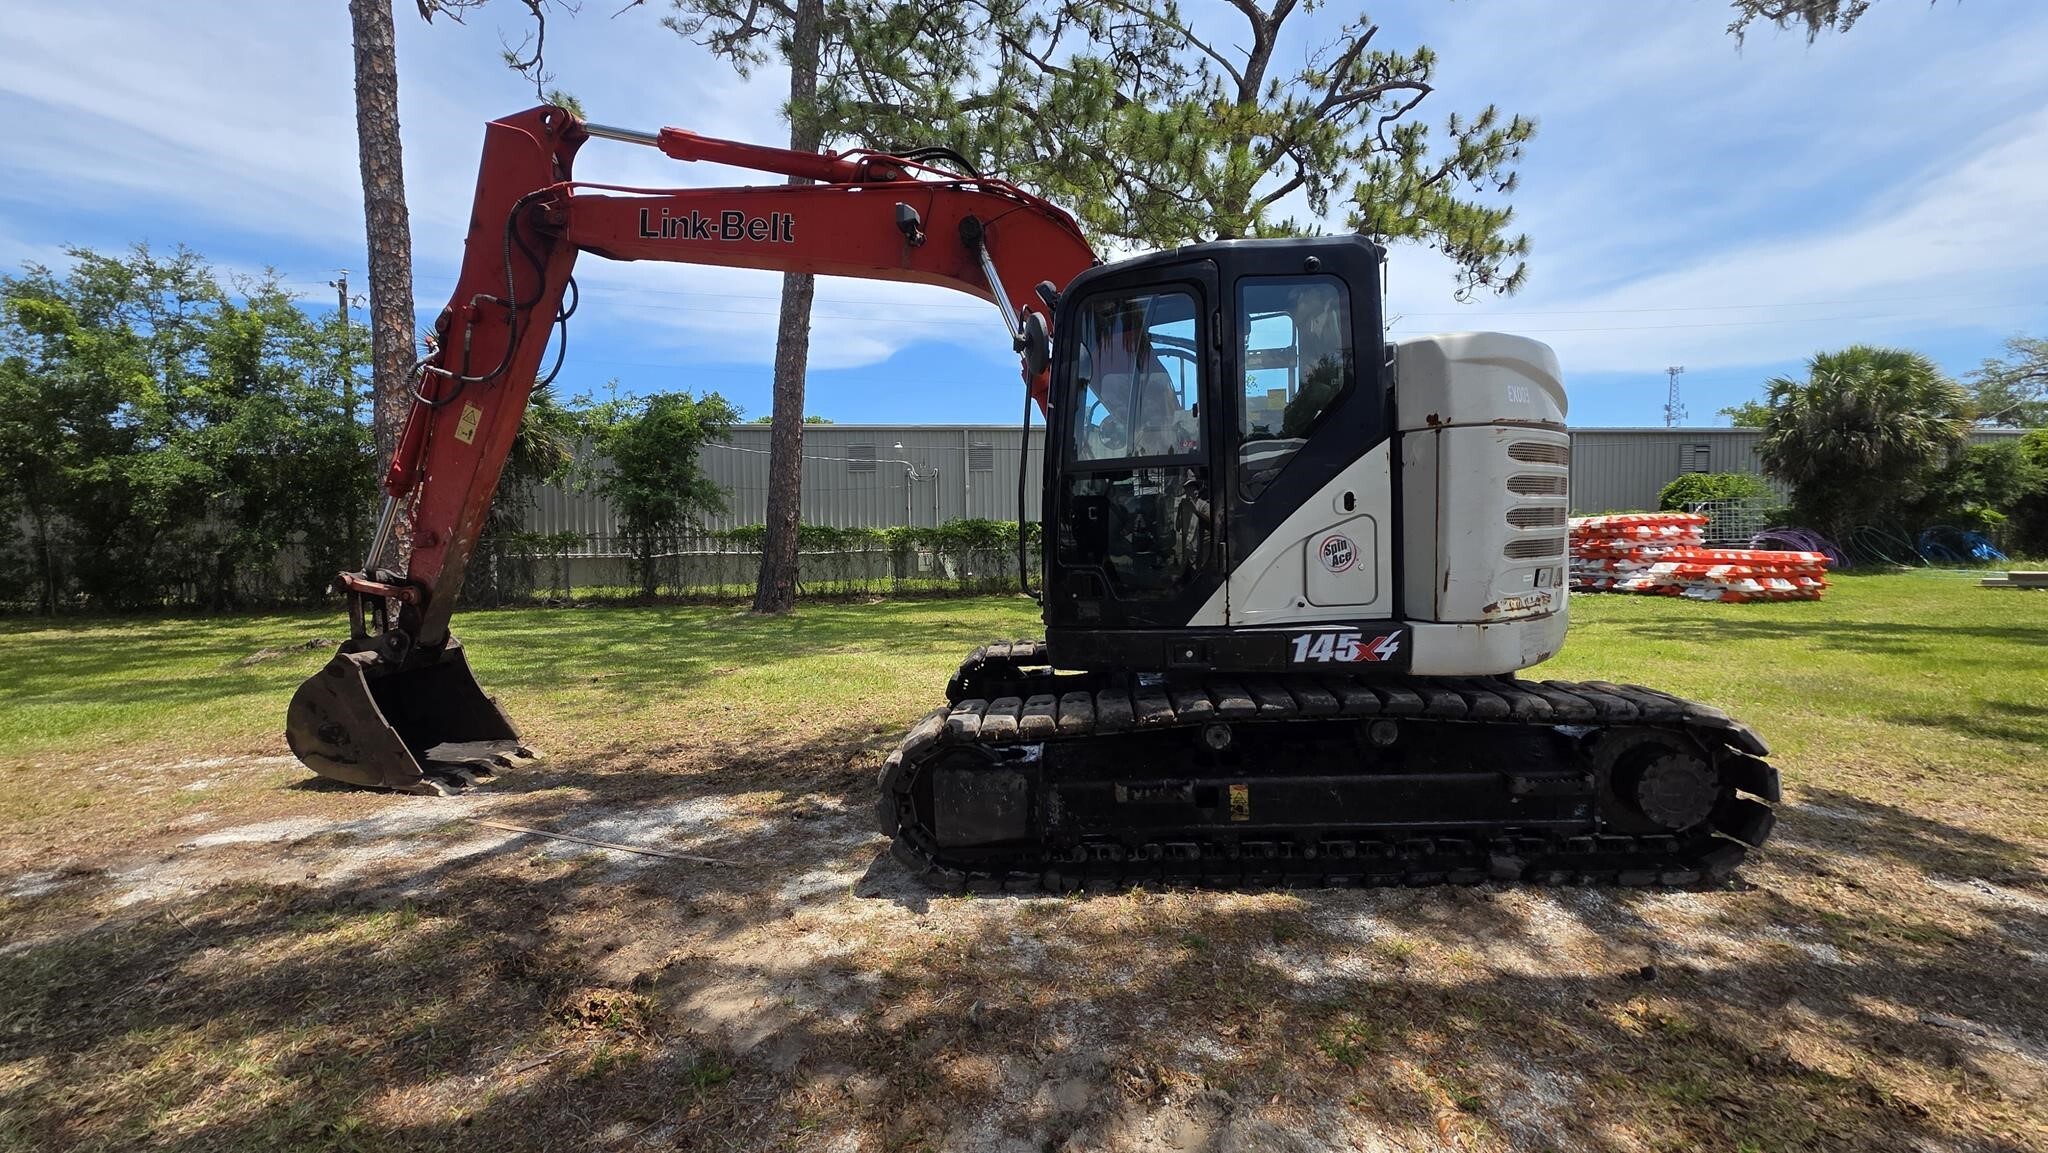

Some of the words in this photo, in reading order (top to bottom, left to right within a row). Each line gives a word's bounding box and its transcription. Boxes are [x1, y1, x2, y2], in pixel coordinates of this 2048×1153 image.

[639, 207, 795, 242] Link-Belt
[1325, 539, 1348, 556] Spin
[1332, 551, 1353, 567] Ace
